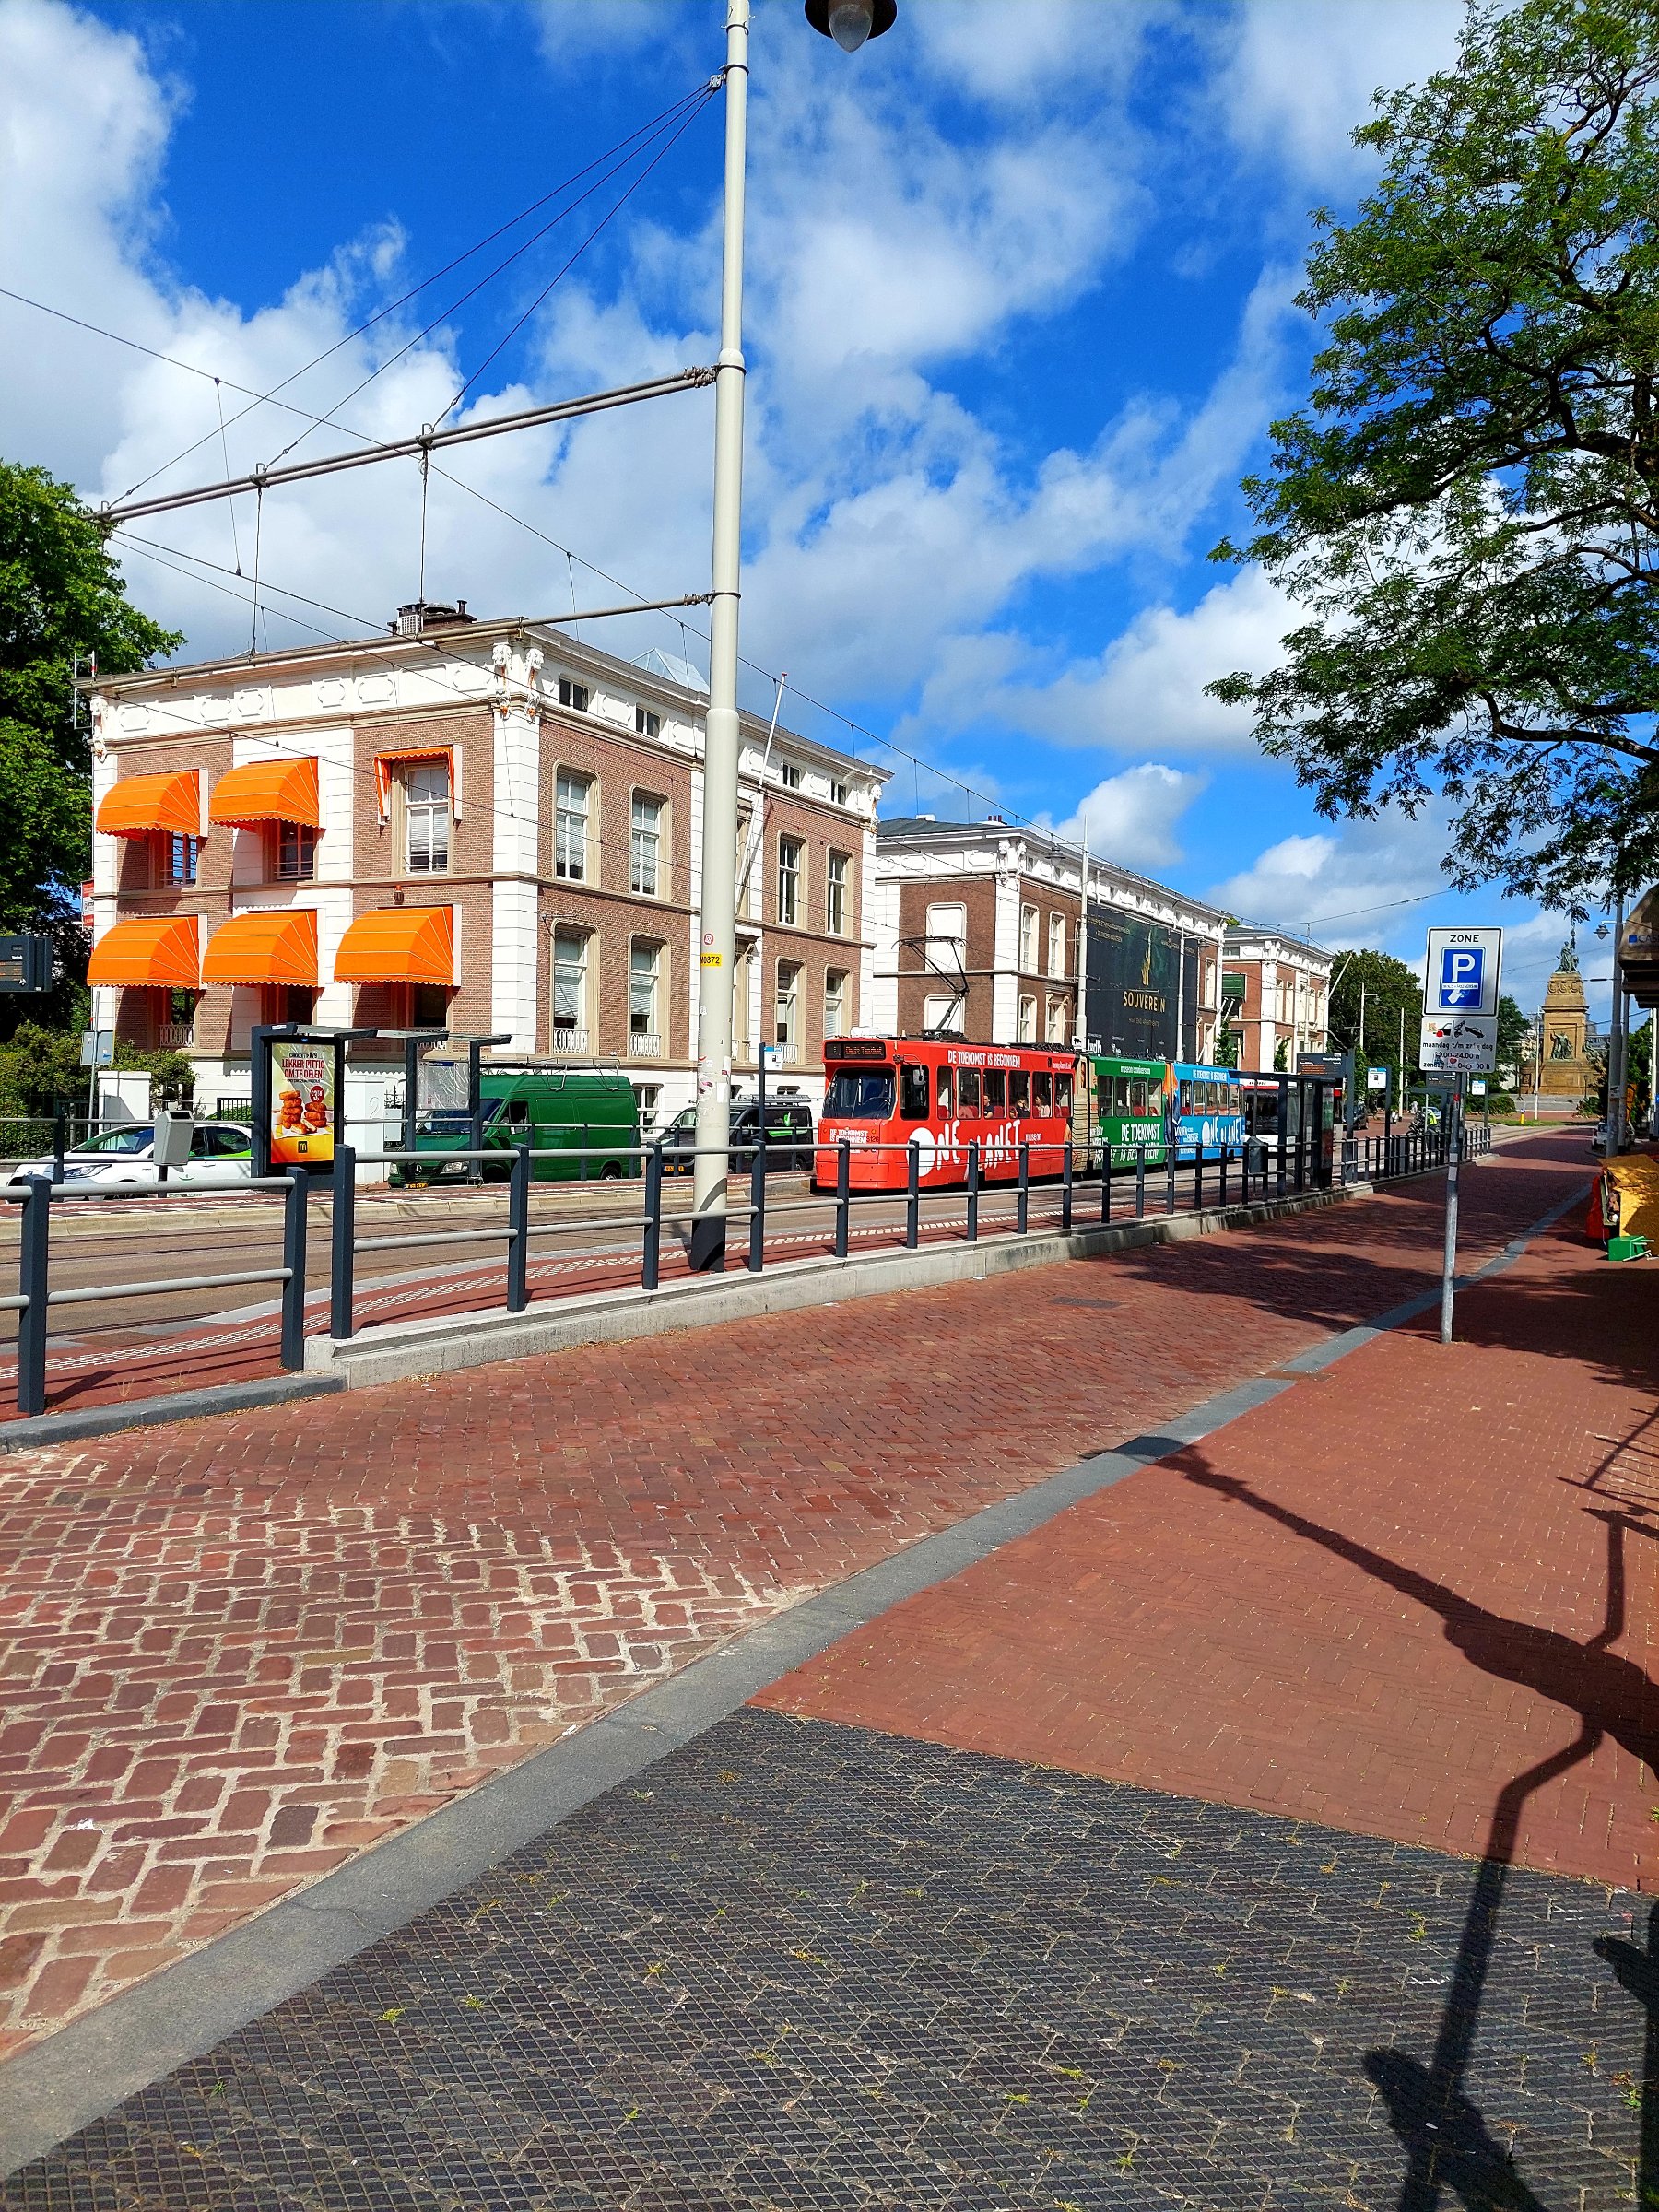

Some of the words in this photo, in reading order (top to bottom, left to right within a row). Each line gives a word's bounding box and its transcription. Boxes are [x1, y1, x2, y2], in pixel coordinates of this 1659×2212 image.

[1450, 935, 1480, 943] ZONE
[1452, 953, 1476, 983] P
[1123, 990, 1166, 1013] SOUVEREIN
[281, 1059, 304, 1068] LEKKER
[305, 1060, 325, 1069] PITTIG
[947, 1049, 957, 1065] DE
[958, 1051, 986, 1066] TOEKOMST
[284, 1069, 294, 1078] OM
[295, 1069, 303, 1078] TE
[303, 1070, 323, 1079] DELEN
[838, 1129, 868, 1137] TOEKOMST
[1121, 1124, 1130, 1142] DE
[1130, 1124, 1160, 1142] TOEKOMST
